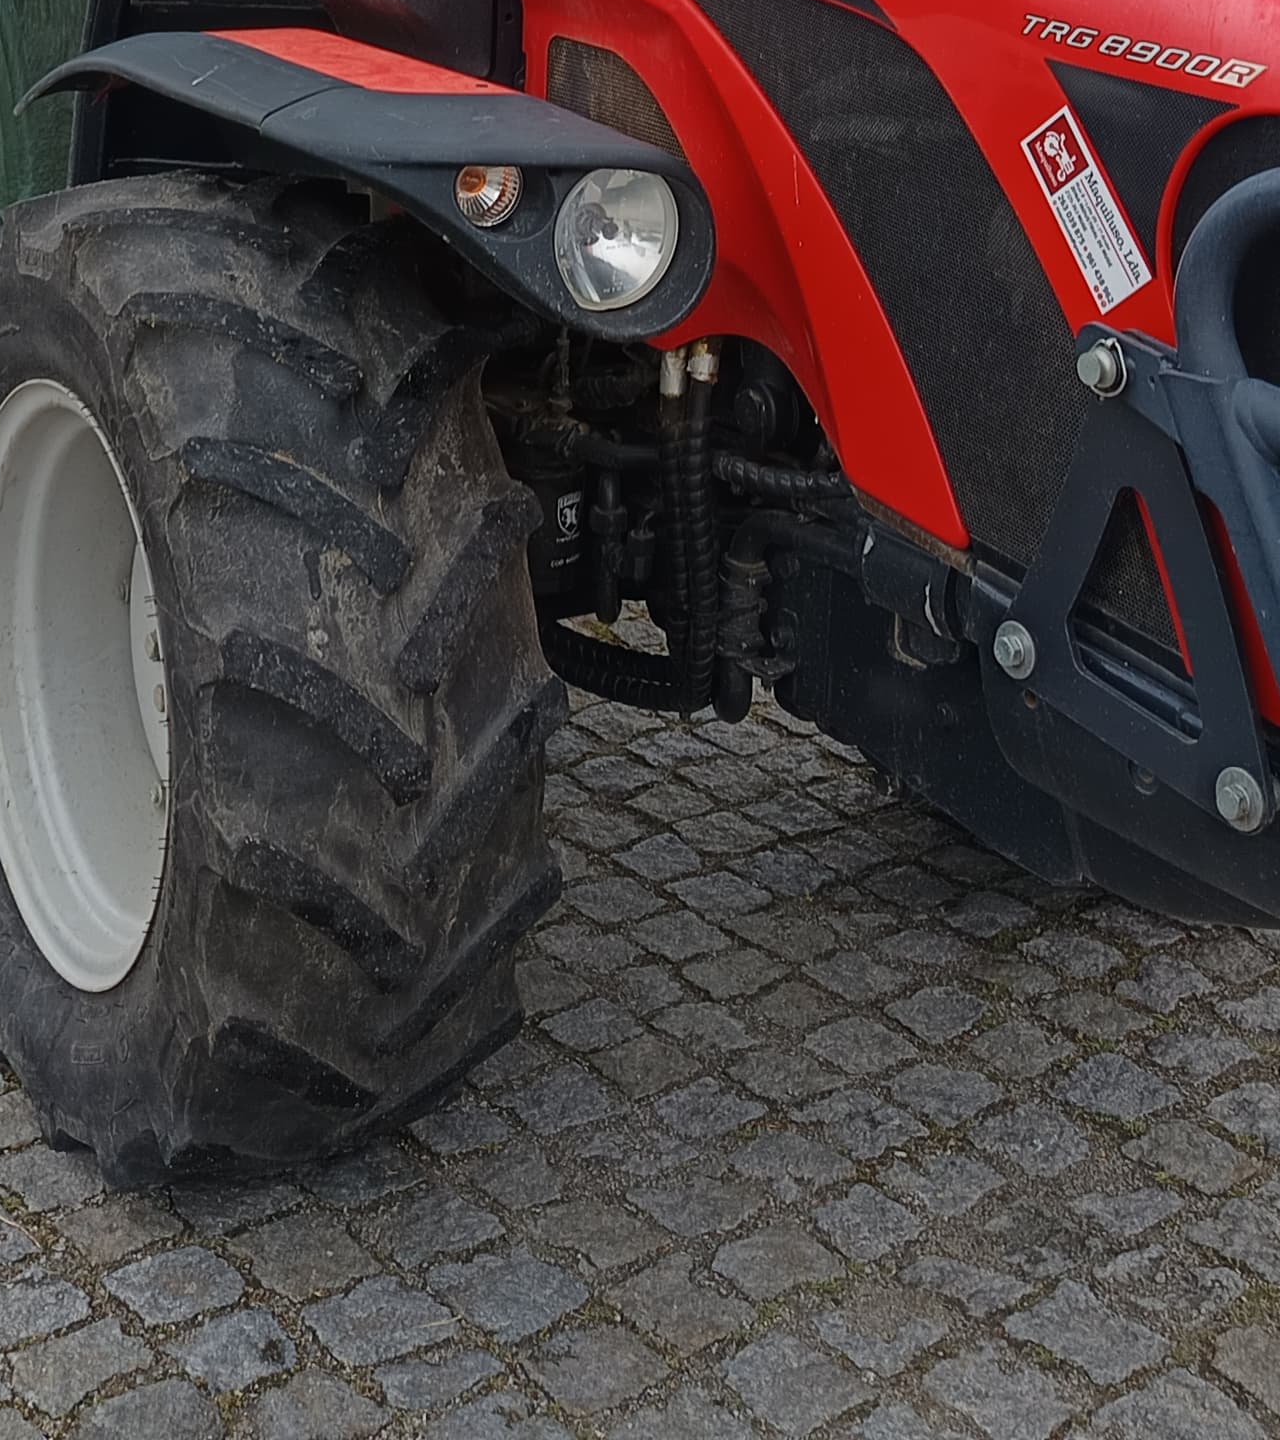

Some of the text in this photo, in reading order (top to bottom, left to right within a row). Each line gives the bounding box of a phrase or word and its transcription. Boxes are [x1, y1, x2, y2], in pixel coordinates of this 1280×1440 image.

[1022, 14, 1099, 49] TRG
[1085, 171, 1126, 250] Maquiluso,
[1124, 250, 1141, 283] Lda.
